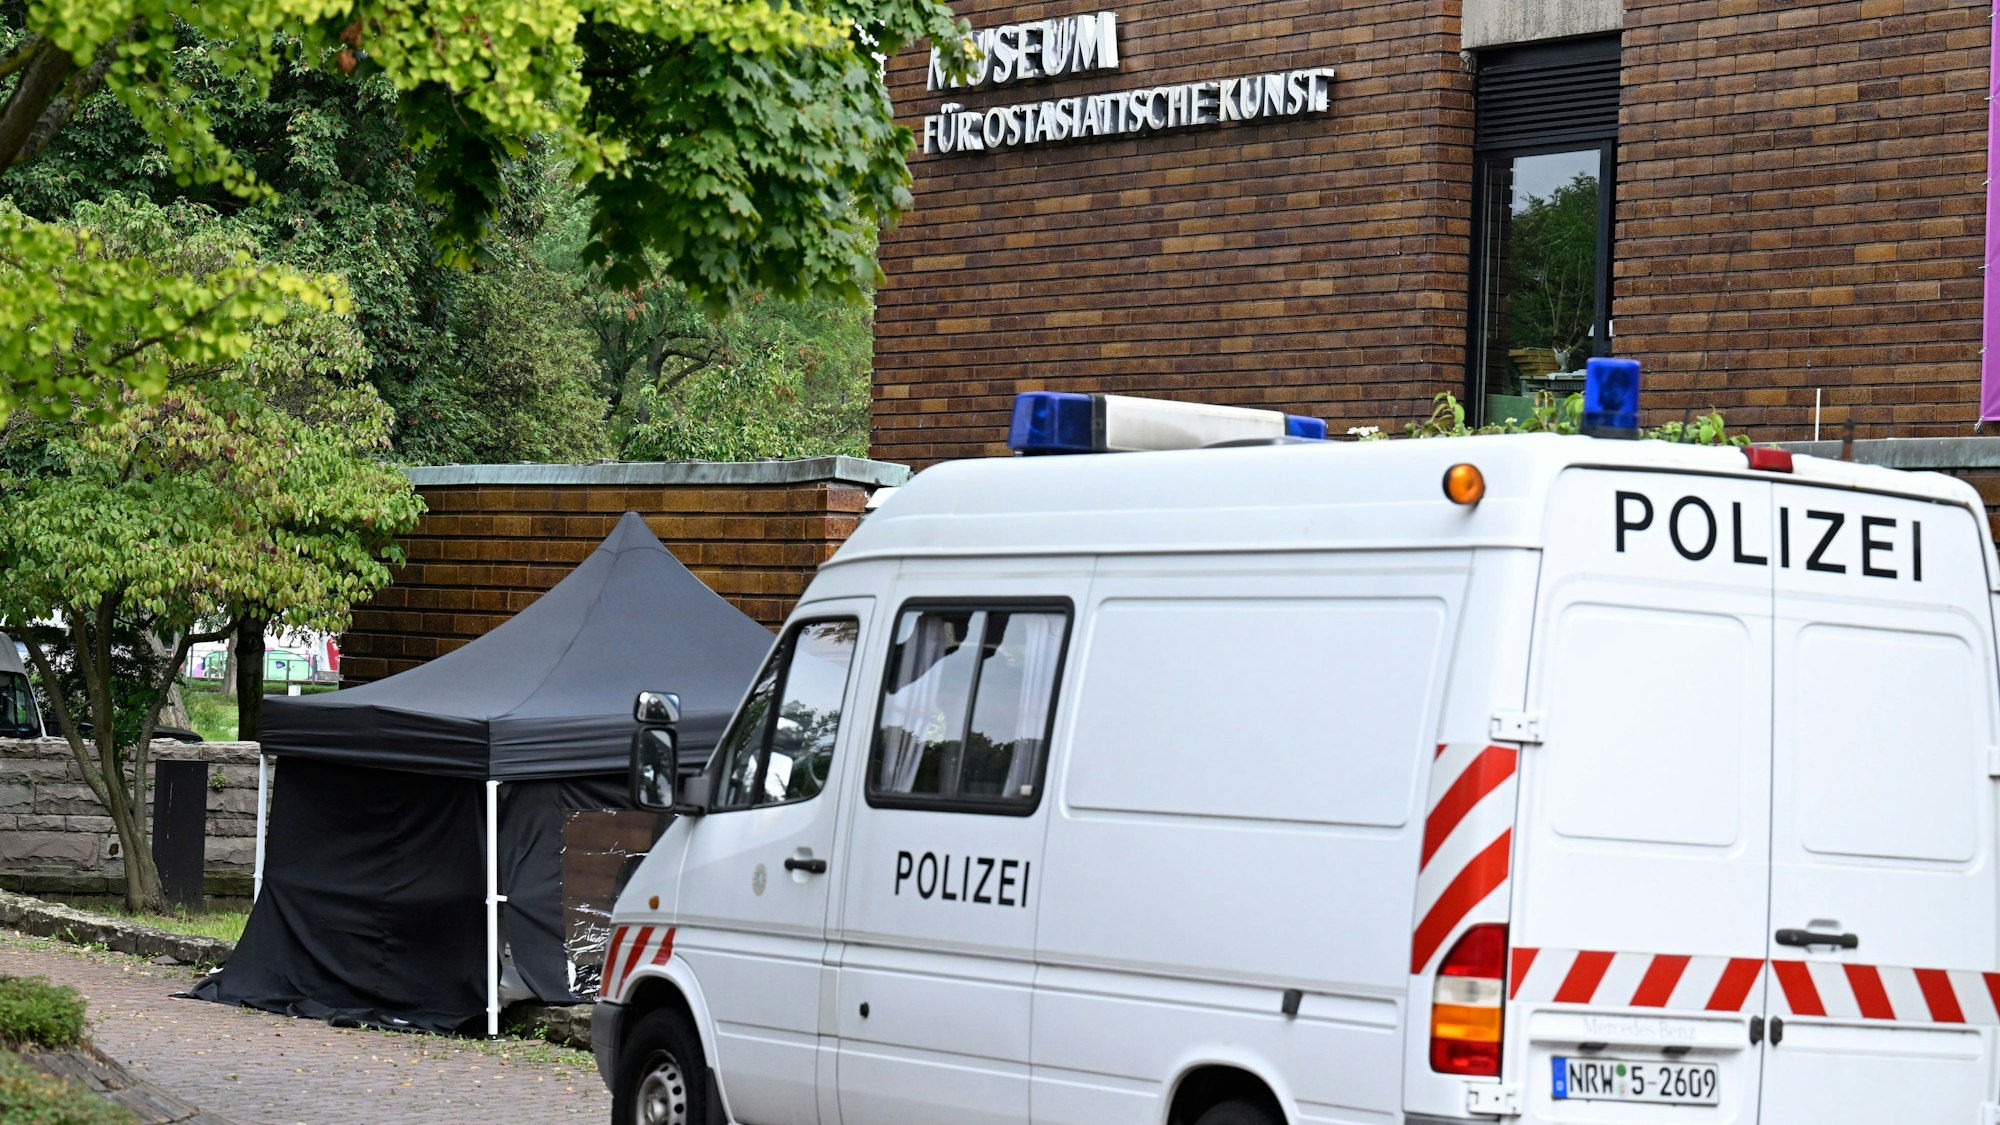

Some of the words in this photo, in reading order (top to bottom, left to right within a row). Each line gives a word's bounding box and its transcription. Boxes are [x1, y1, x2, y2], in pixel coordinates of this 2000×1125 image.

[923, 103, 982, 154] FÜR
[983, 82, 1217, 149] OSTASIATISCHE
[1219, 68, 1334, 121] KUNST
[1615, 490, 1922, 582] POLIZEI
[894, 850, 1030, 908] POLIZEI
[1569, 1063, 1614, 1094] NRW
[1631, 1065, 1716, 1098] 5-2609
